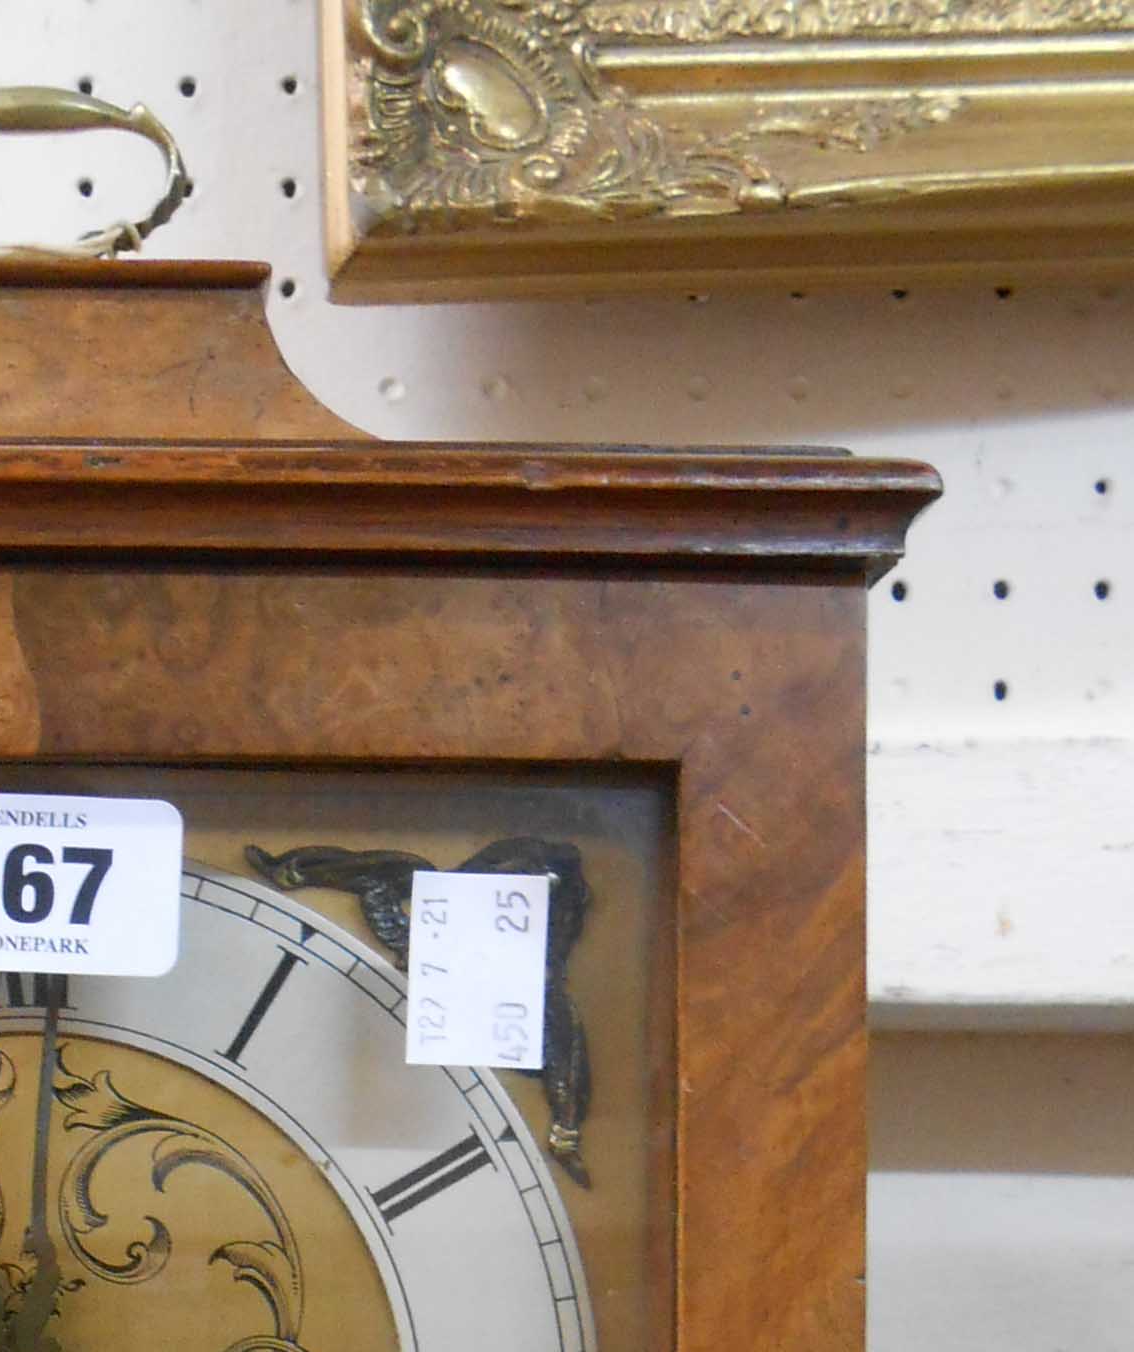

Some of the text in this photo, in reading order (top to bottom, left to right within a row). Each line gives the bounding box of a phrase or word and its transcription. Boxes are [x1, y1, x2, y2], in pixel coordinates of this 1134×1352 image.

[213, 944, 309, 1071] I
[493, 890, 531, 1063] 450 25
[364, 1122, 498, 1236] II
